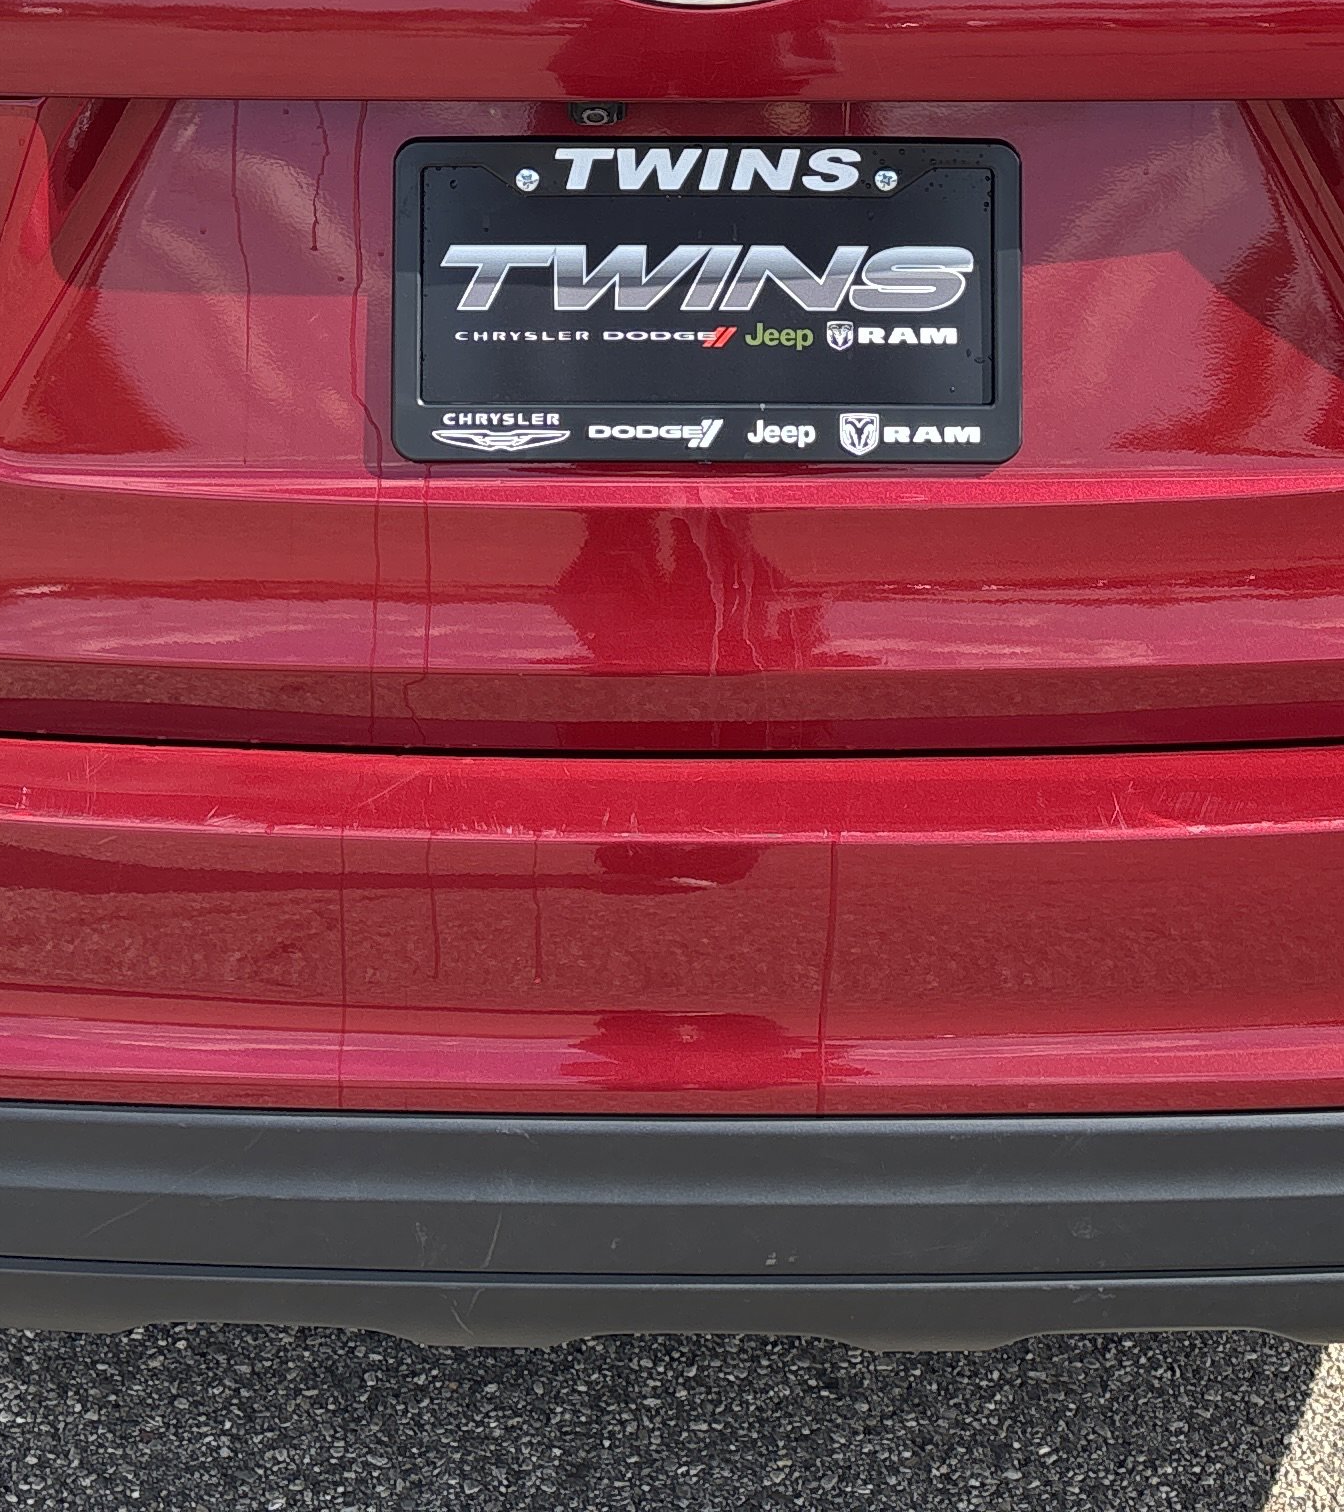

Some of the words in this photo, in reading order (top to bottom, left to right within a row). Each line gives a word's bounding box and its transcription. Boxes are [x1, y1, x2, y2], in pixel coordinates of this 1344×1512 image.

[555, 148, 862, 191] TWINS
[440, 244, 974, 311] TWINS
[455, 330, 589, 341] CHRYSLER
[603, 330, 717, 341] DODGE
[745, 322, 814, 350] Jeep
[858, 327, 957, 345] RAM
[442, 412, 560, 426] CHRYSLER
[588, 425, 703, 440] DODGE
[747, 420, 816, 448] Jeep
[883, 426, 981, 443] RAM
